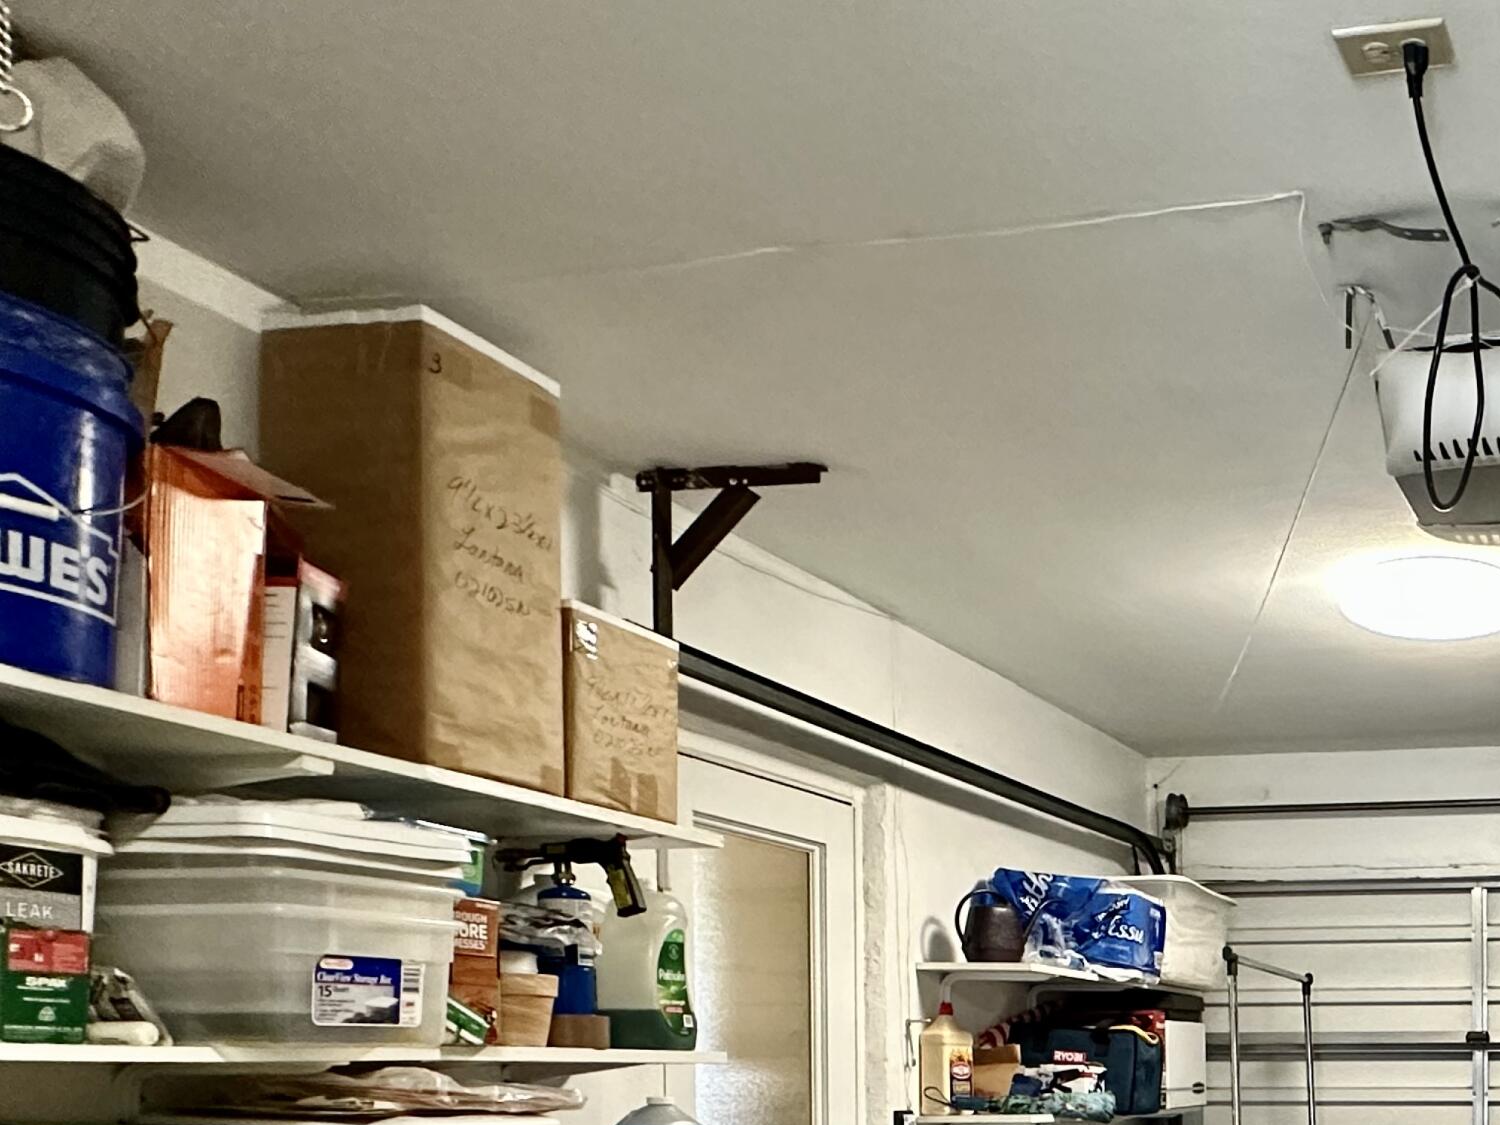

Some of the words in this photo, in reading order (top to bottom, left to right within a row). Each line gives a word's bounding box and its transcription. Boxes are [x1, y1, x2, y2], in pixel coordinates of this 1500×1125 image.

[428, 352, 442, 374] 3
[8, 861, 57, 880] SAKRETE
[6, 901, 54, 920] LEAK
[455, 922, 489, 940] ORE
[319, 984, 333, 998] 15
[1053, 1050, 1087, 1062] RYOBI
